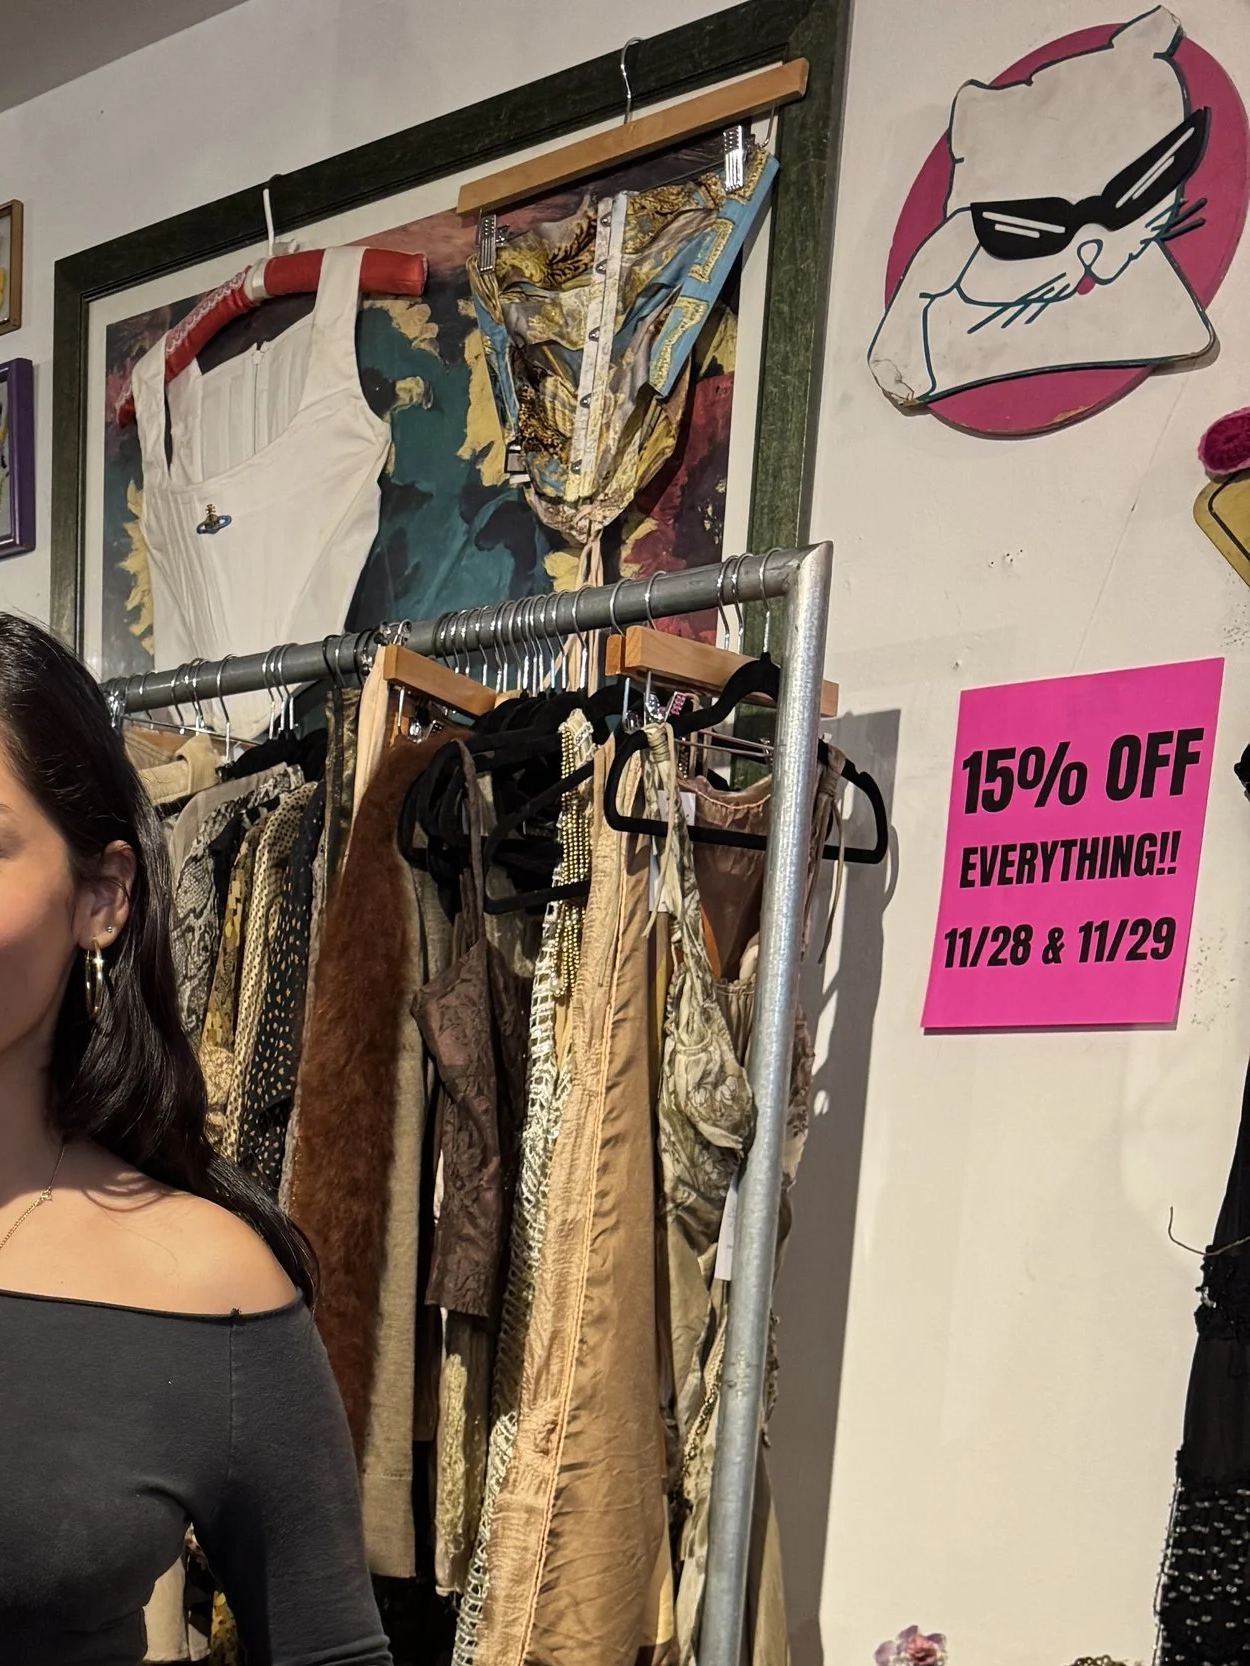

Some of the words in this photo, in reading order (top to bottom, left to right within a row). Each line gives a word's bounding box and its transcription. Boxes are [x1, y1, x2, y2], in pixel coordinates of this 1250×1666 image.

[962, 741, 1088, 815] 15%
[1105, 727, 1205, 801] OFF
[959, 830, 1182, 888] EVERYTHING!!
[944, 924, 1033, 968] 11/28
[1042, 926, 1065, 964] &
[1078, 916, 1177, 963] 11/29
